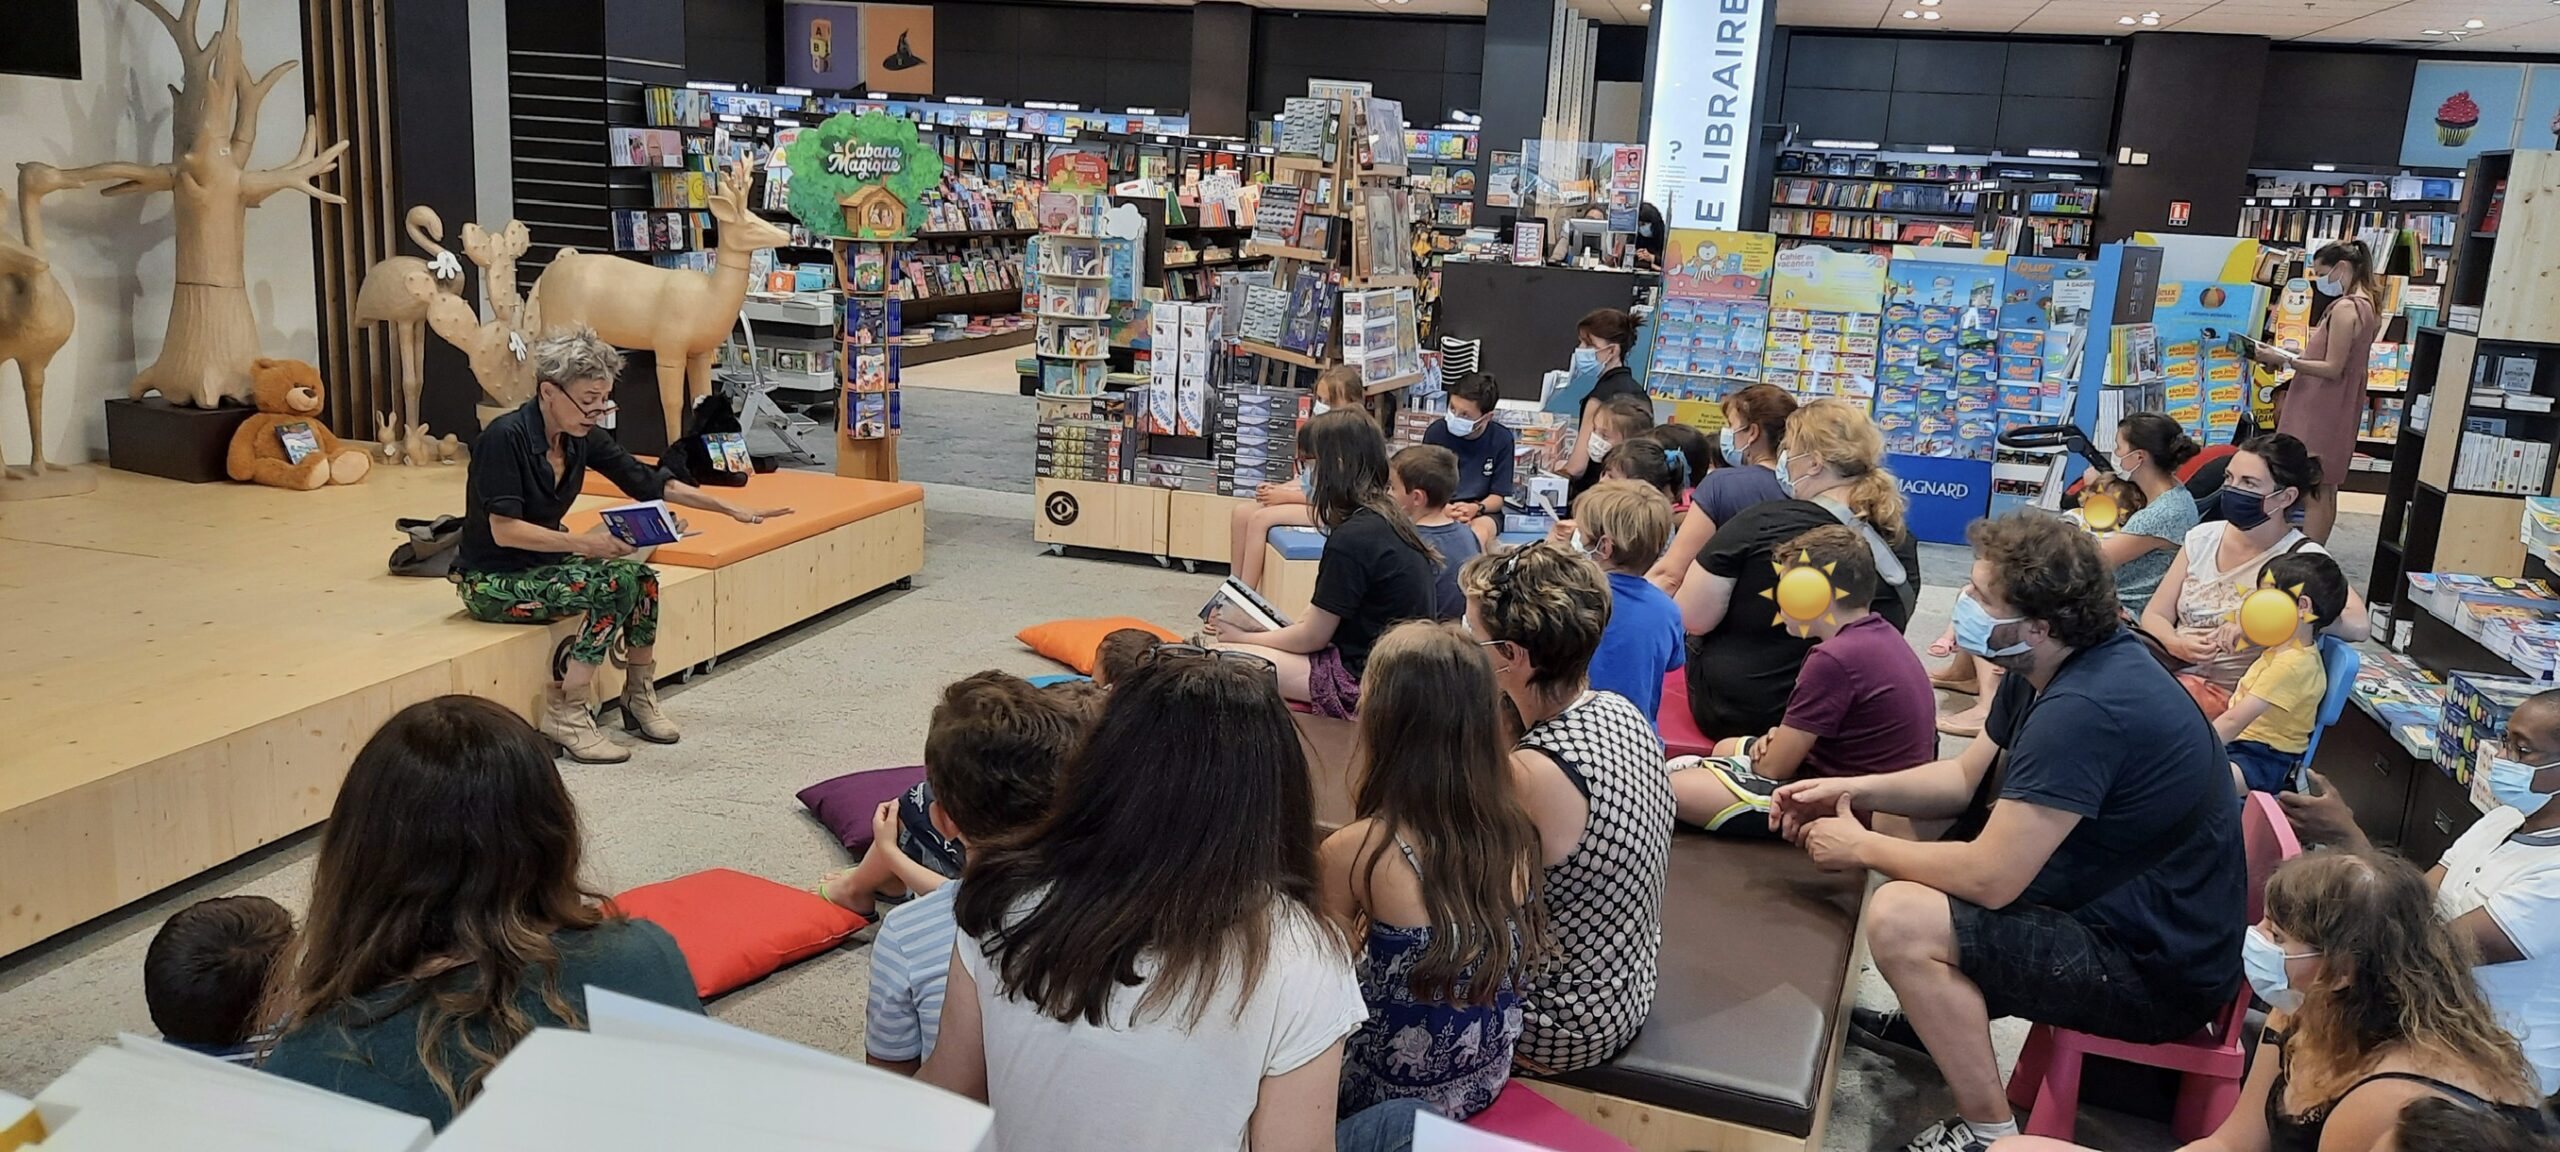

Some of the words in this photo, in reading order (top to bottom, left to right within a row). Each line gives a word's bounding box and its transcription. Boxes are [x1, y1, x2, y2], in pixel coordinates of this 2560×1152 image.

[1700, 0, 1750, 184] LIBRAIRE
[845, 140, 902, 159] Cabane
[828, 153, 901, 180] Magique
[1777, 259, 1815, 268] vacances
[1780, 253, 1805, 261] Cahier
[2011, 259, 2055, 273] Jouer
